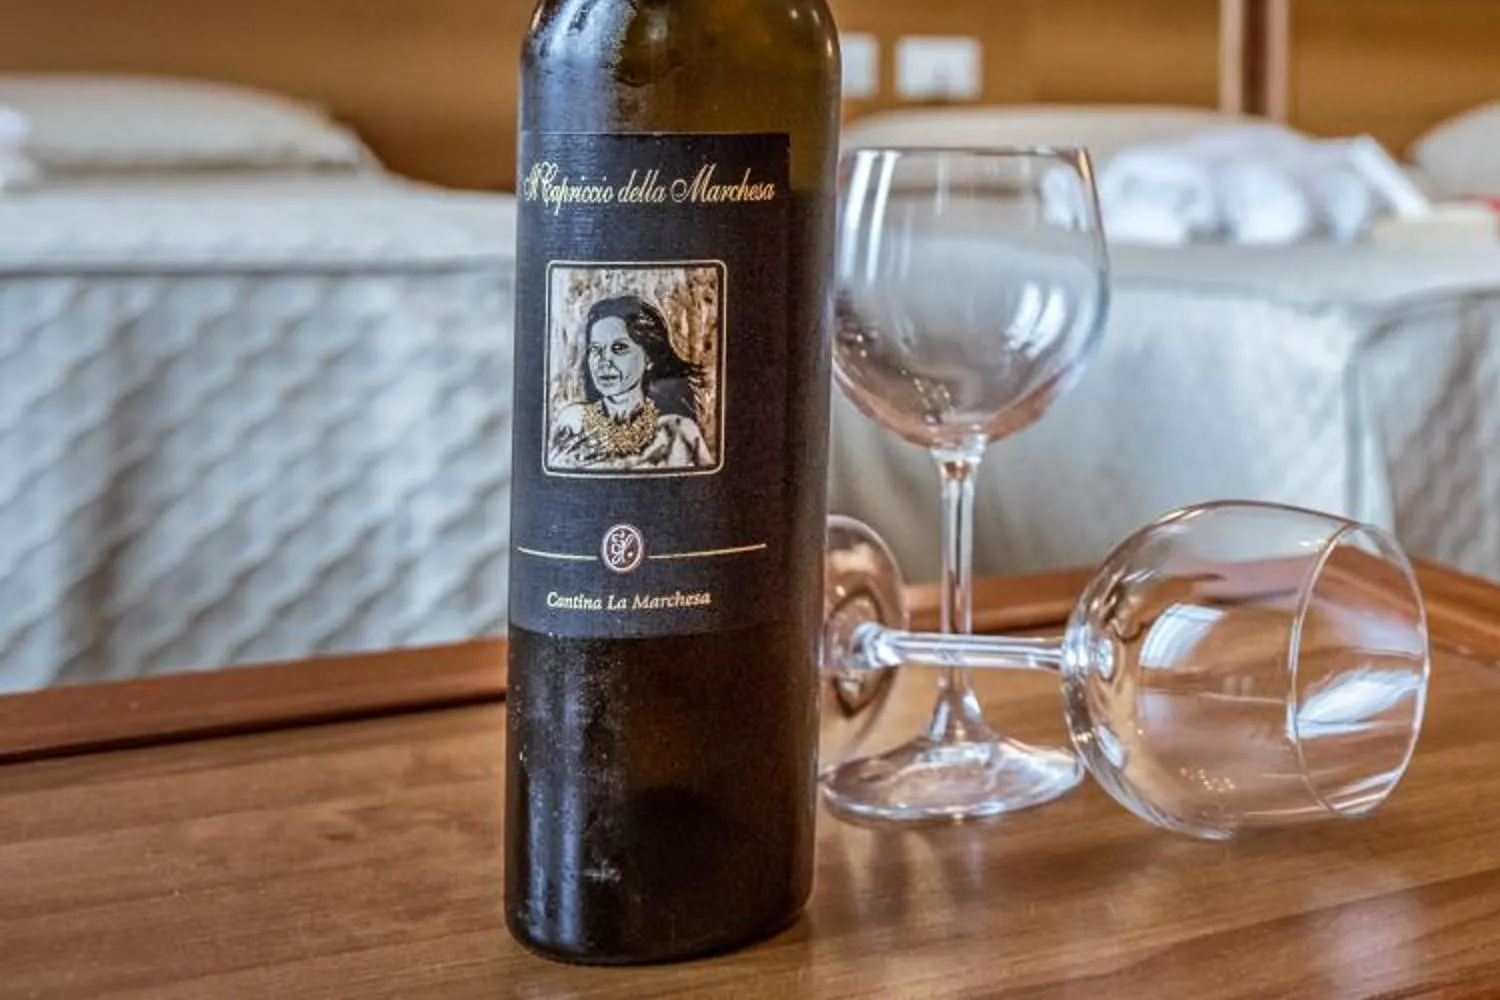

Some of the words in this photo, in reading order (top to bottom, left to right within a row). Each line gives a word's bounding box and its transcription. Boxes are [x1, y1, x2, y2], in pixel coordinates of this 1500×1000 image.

[541, 161, 615, 216] Capriccio
[617, 168, 667, 203] della
[670, 162, 775, 203] Marchesa
[547, 591, 601, 610] Cantina
[607, 594, 628, 611] La
[632, 590, 711, 610] Marchesa
